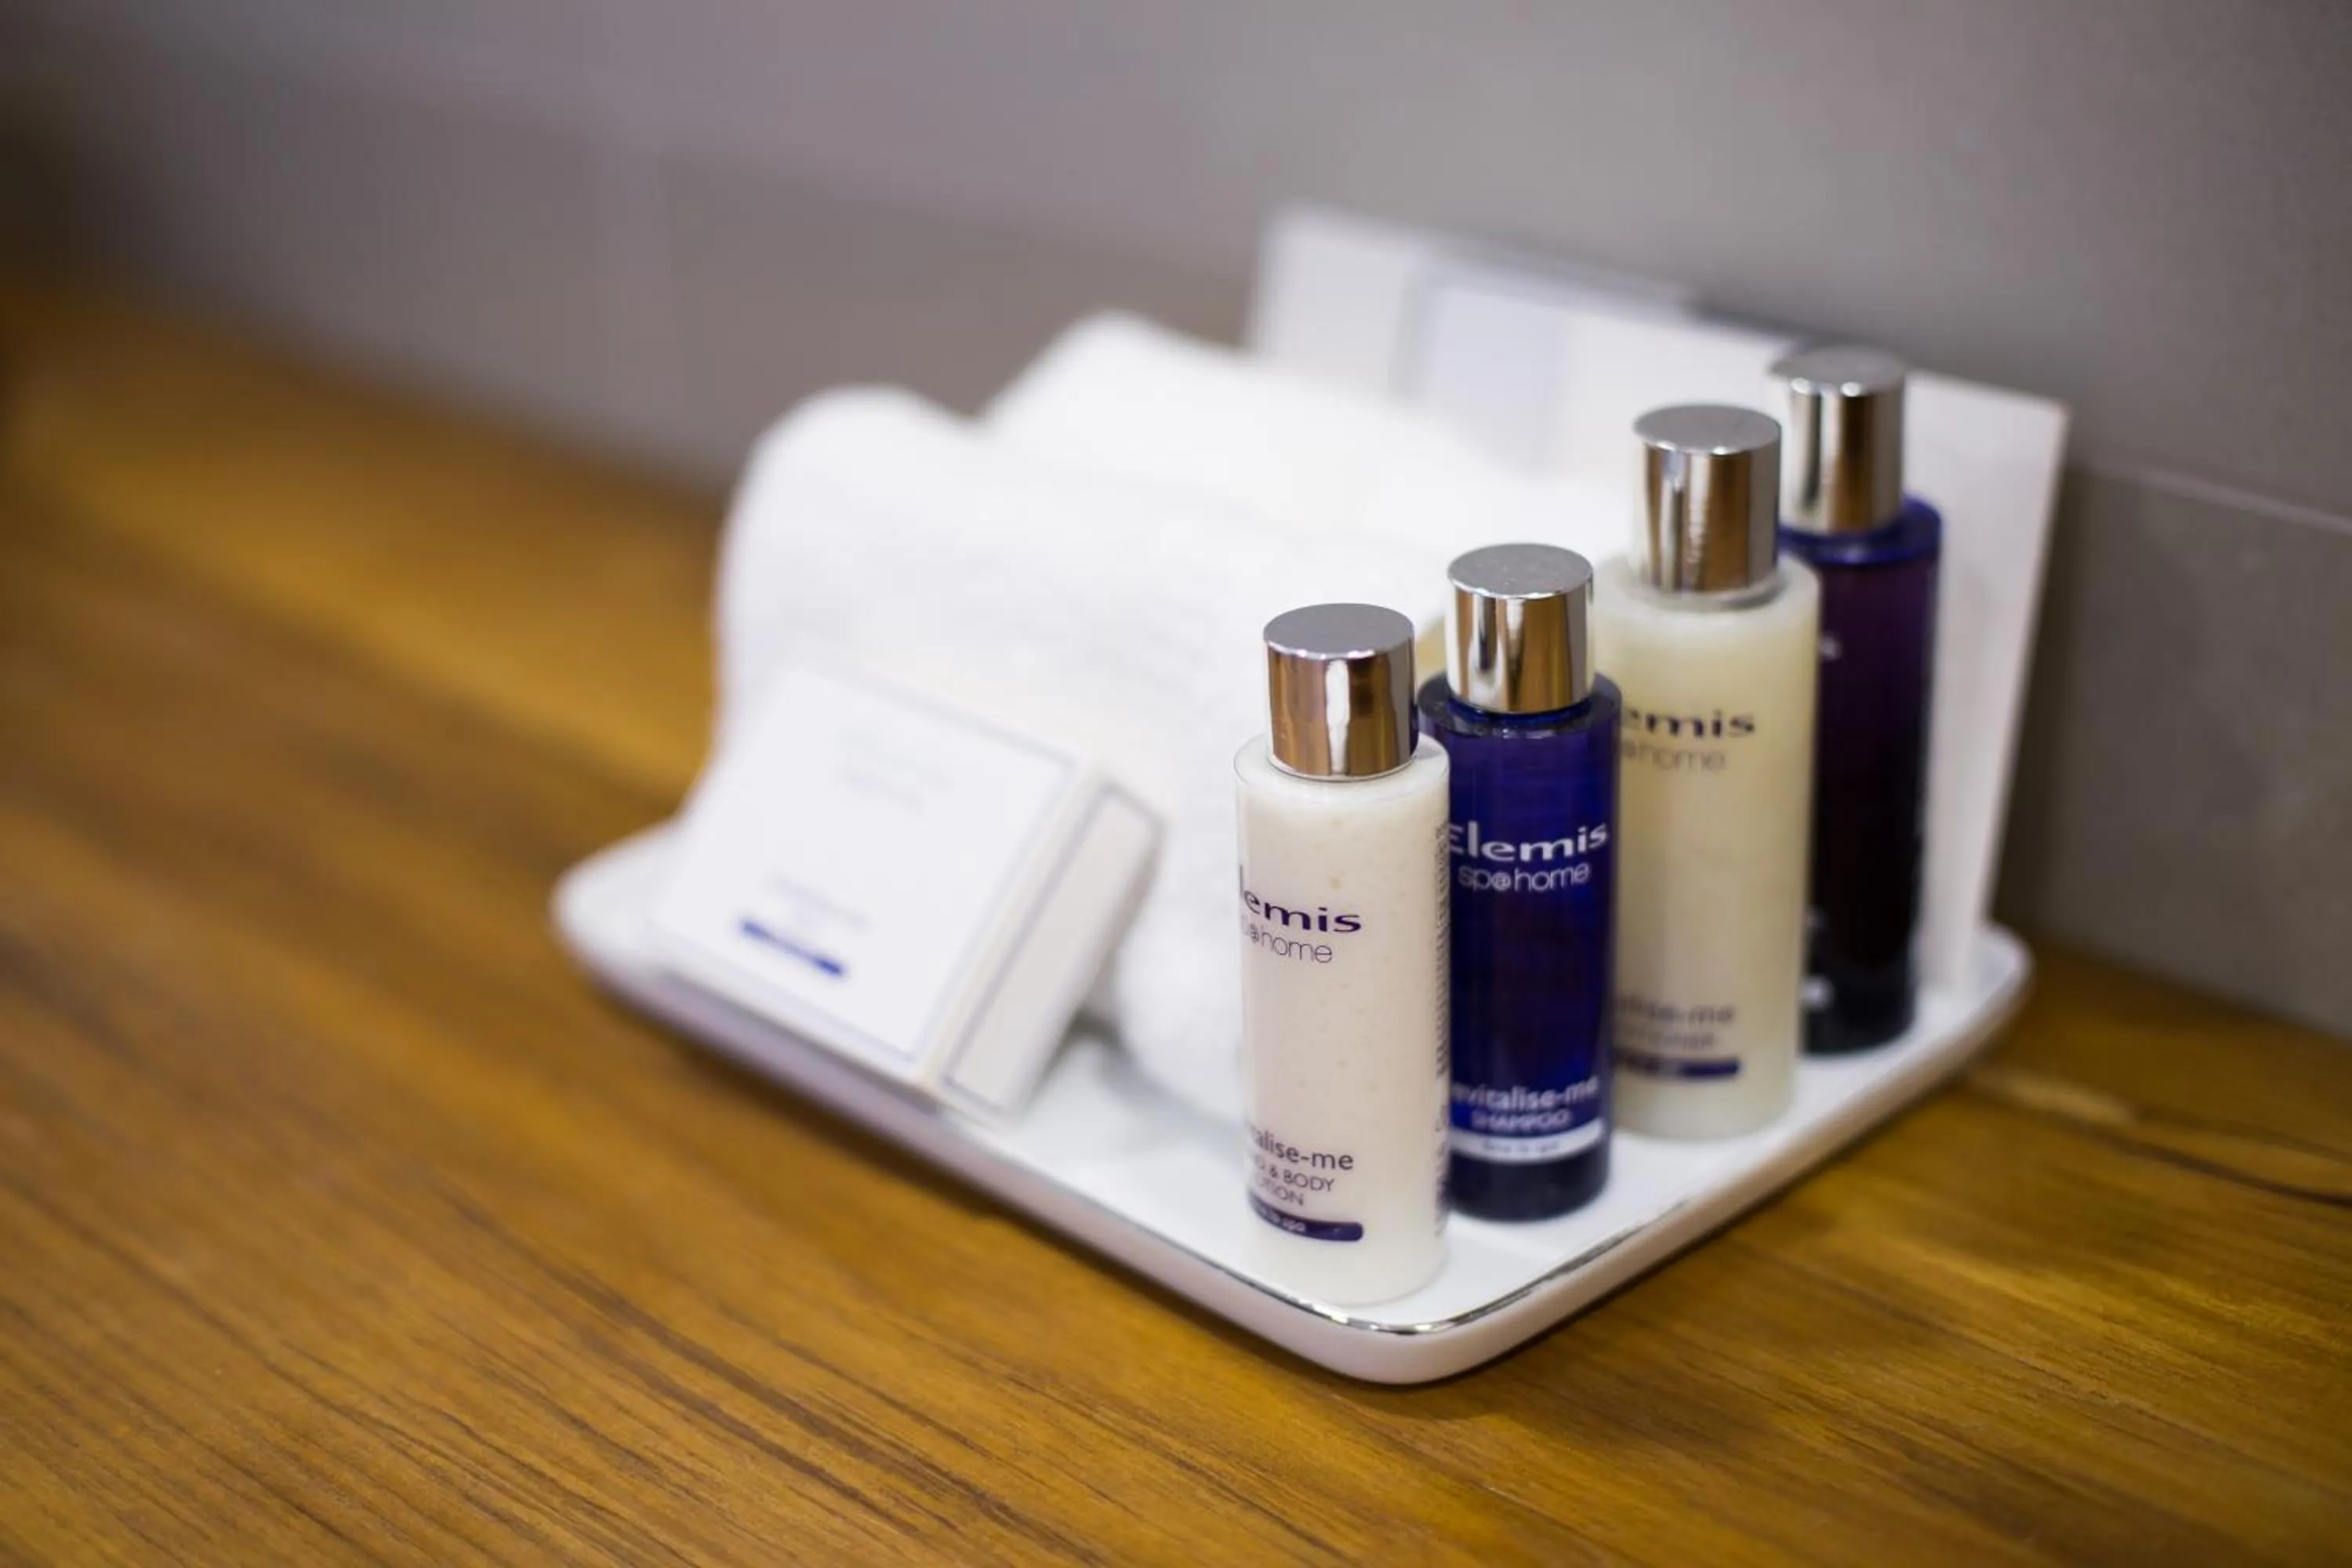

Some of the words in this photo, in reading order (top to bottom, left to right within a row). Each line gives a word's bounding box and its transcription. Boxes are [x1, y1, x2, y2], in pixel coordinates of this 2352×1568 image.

[1623, 706, 1755, 738] emis
[1450, 820, 1608, 862] Elemis
[1239, 864, 1362, 933] lemis
[1451, 1076, 1599, 1111] evitalise-me
[1253, 1126, 1354, 1171] alise-me
[1283, 1169, 1335, 1192] BODY
